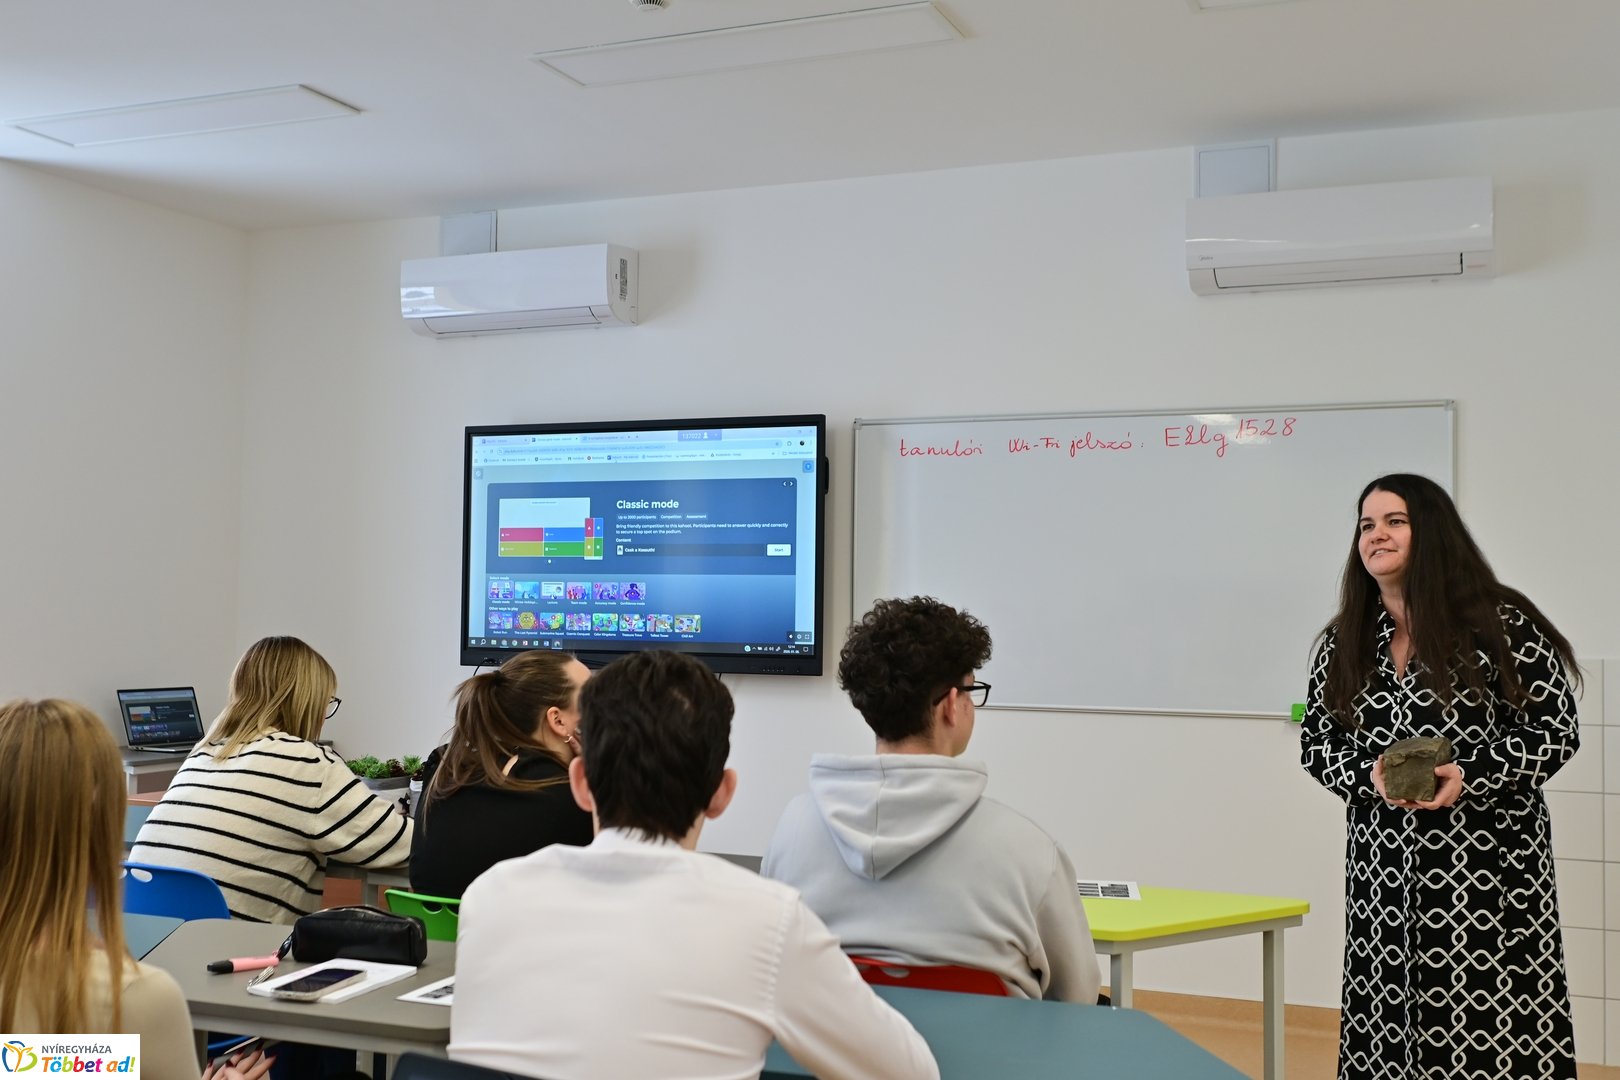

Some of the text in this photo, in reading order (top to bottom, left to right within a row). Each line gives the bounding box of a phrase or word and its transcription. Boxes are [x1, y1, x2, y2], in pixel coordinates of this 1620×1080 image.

[899, 438, 983, 457] tanulói
[1008, 437, 1061, 453] Wi-Fi
[616, 499, 680, 509] Classic mode
